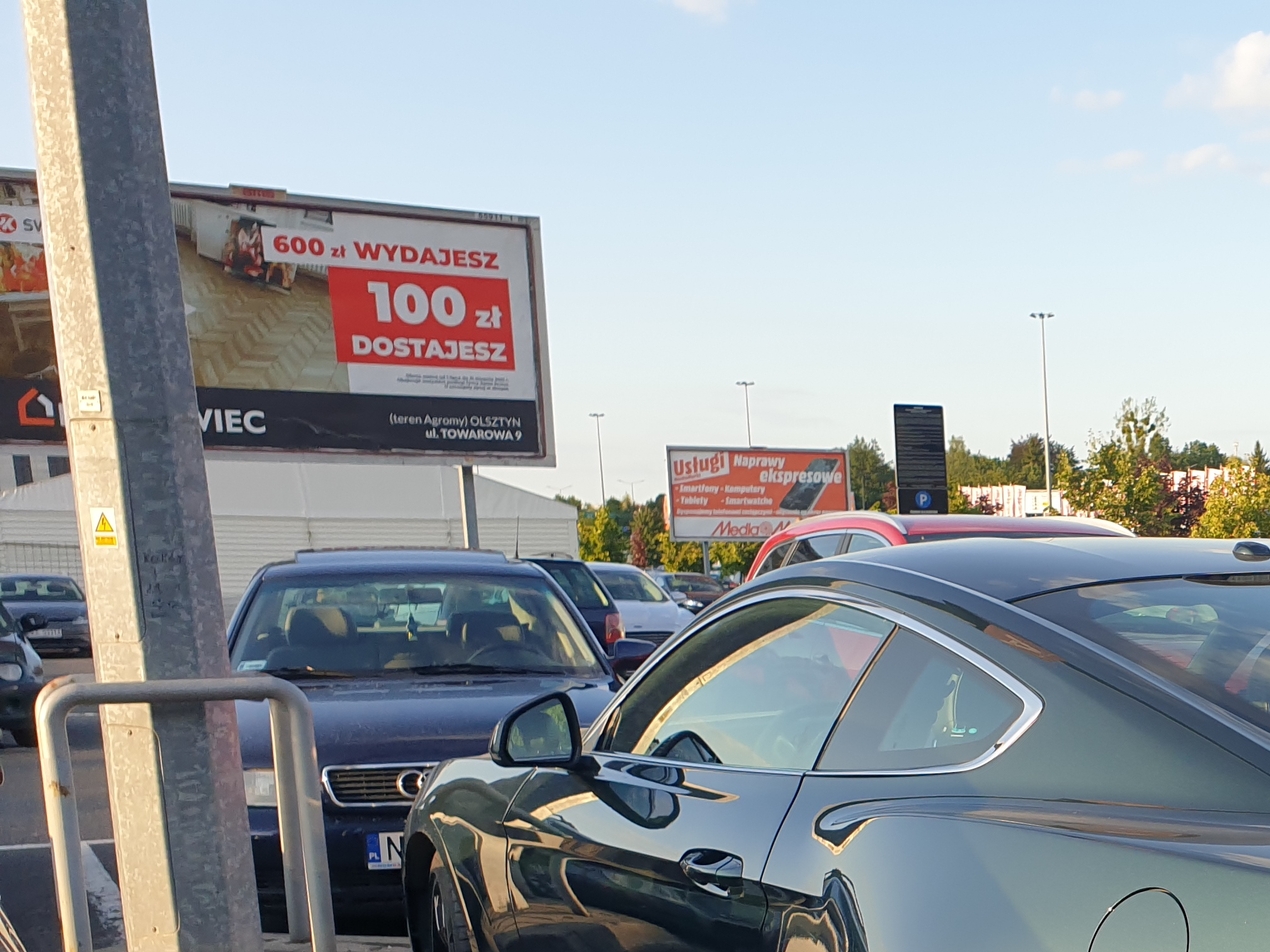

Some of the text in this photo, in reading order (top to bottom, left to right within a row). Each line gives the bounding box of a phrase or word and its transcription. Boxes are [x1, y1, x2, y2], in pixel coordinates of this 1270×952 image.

[273, 235, 499, 269] 600 zł WYDAJESZ
[368, 281, 502, 328] 100 zł
[352, 335, 507, 362] DOSTAJESZ
[390, 413, 521, 427] (teren Agromy) OLSZTYN
[425, 428, 523, 440] ul. TOWAROWA 9
[674, 451, 725, 476] Usługi
[734, 454, 785, 469] Naprawy
[760, 469, 842, 485] ekspresowe
[712, 520, 760, 536] Media
[369, 852, 379, 860] PL
